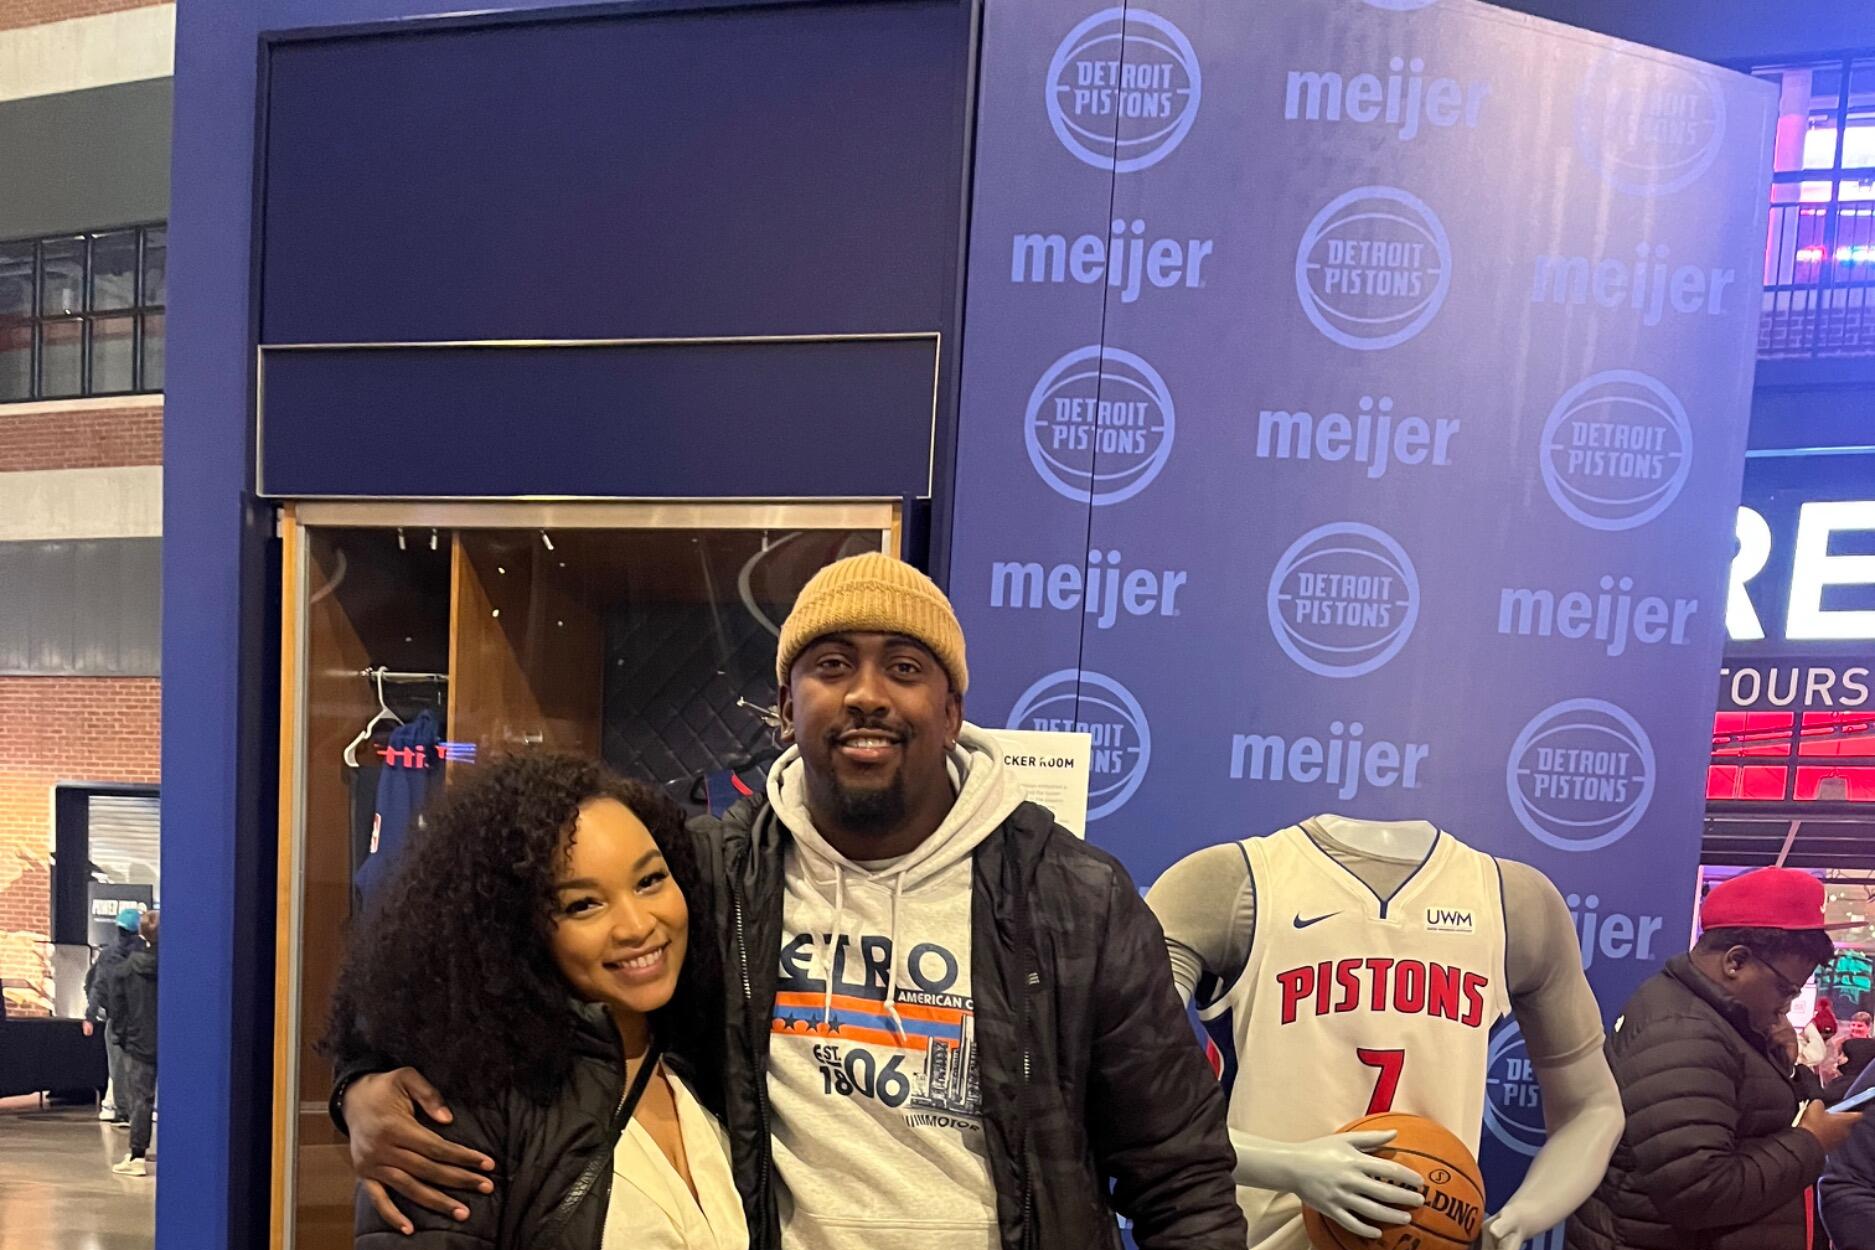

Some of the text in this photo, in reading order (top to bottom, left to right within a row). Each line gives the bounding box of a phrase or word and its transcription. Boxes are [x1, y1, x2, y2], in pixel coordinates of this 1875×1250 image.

[1076, 61, 1173, 89] DETROIT
[1074, 89, 1172, 118] PISTONS
[1284, 57, 1492, 142] meijer
[1011, 219, 1213, 303] meijer
[1328, 239, 1424, 268] DETROIT
[1324, 267, 1423, 297] PISTONS
[1533, 242, 1735, 327] meijer
[1054, 397, 1149, 426] DETROIT
[1051, 425, 1147, 454] PISTONS
[1255, 396, 1460, 479] meijer
[1571, 421, 1667, 451] DETROIT
[1568, 450, 1665, 479] PISTONS
[990, 549, 1188, 629] meijer
[1298, 572, 1393, 600] DETROIT
[1295, 599, 1391, 628] PISTONS
[1497, 575, 1698, 657] meijer
[1004, 755, 1037, 768] CKER
[1229, 721, 1429, 801] meijer
[1537, 748, 1629, 776] DETROIT
[1533, 774, 1627, 803] PISTONS
[1427, 909, 1472, 926] UWM
[779, 933, 958, 994] ETRO
[898, 991, 963, 1007] AMERICAN
[1276, 957, 1488, 1028] PISTONS
[1356, 1048, 1405, 1116] 7
